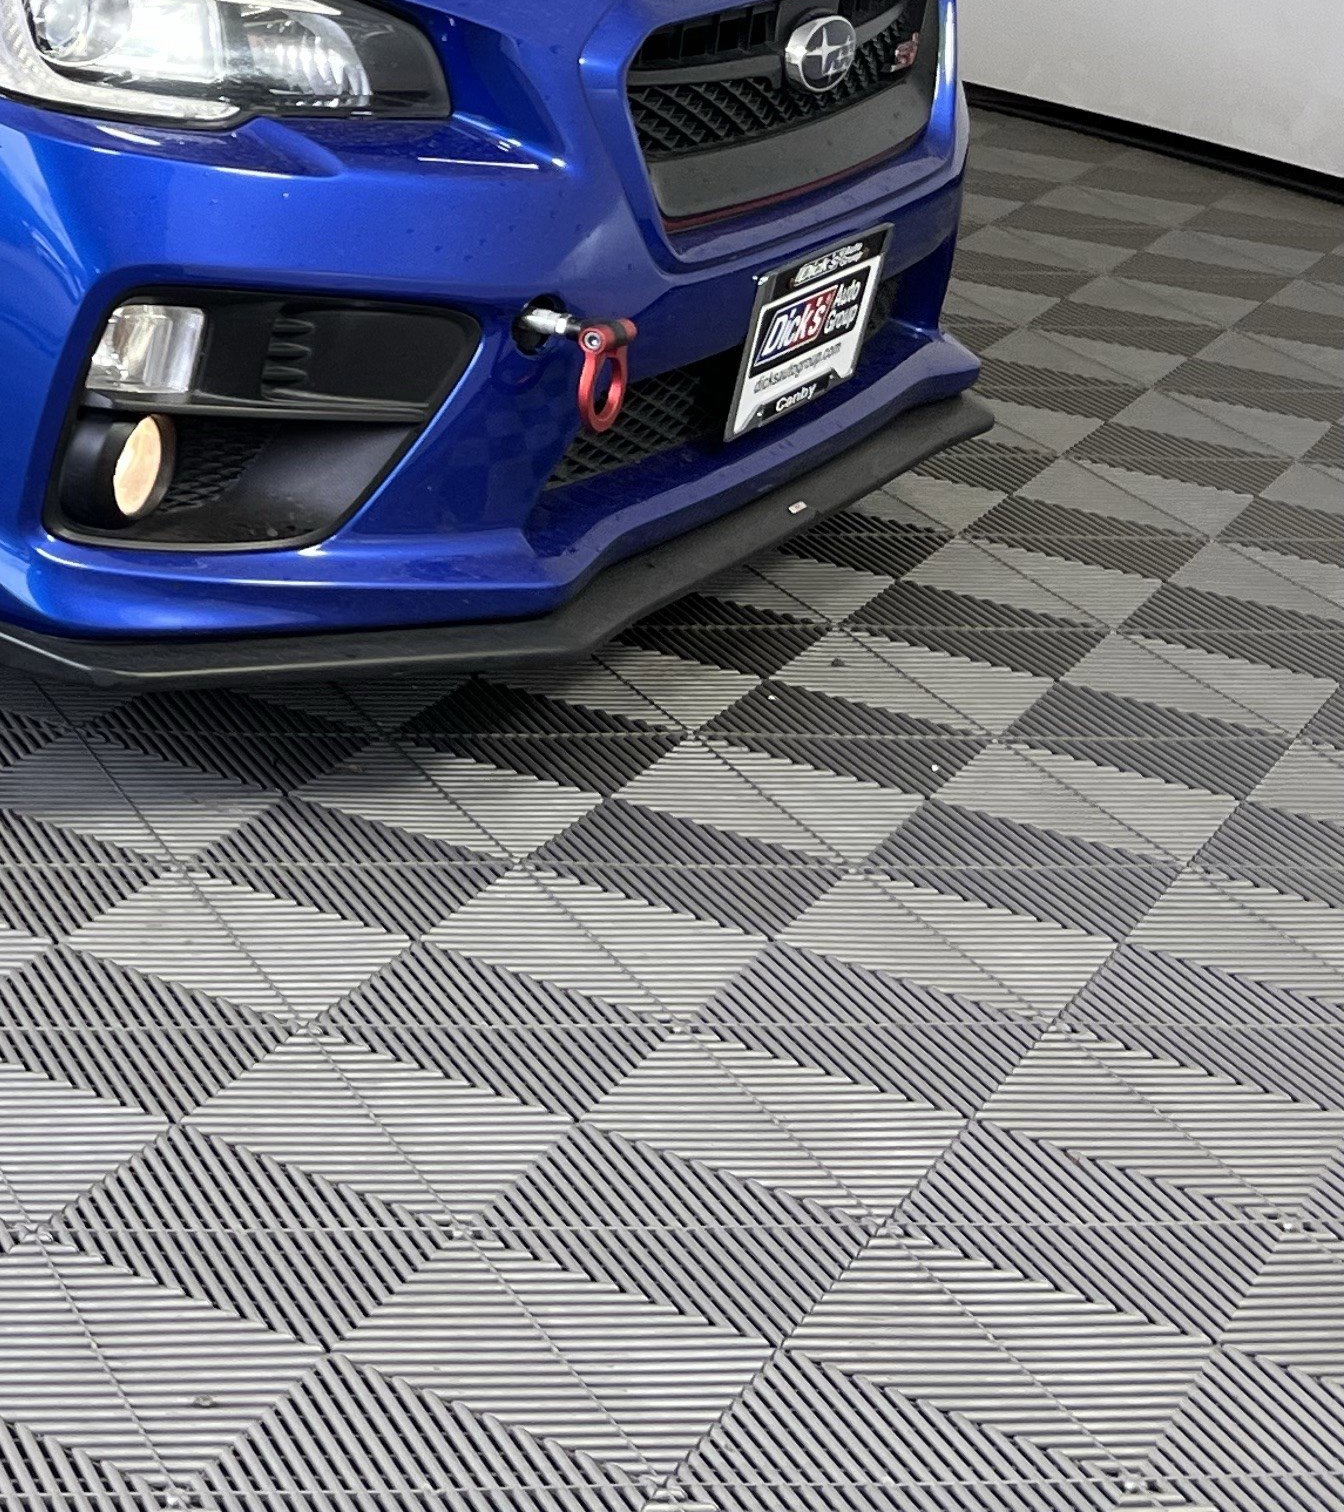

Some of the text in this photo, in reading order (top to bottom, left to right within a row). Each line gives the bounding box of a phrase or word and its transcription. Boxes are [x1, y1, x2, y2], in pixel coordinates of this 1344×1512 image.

[835, 279, 861, 307] Auto
[761, 296, 827, 356] Dick's
[824, 304, 858, 334] Group
[776, 383, 817, 412] Canby
